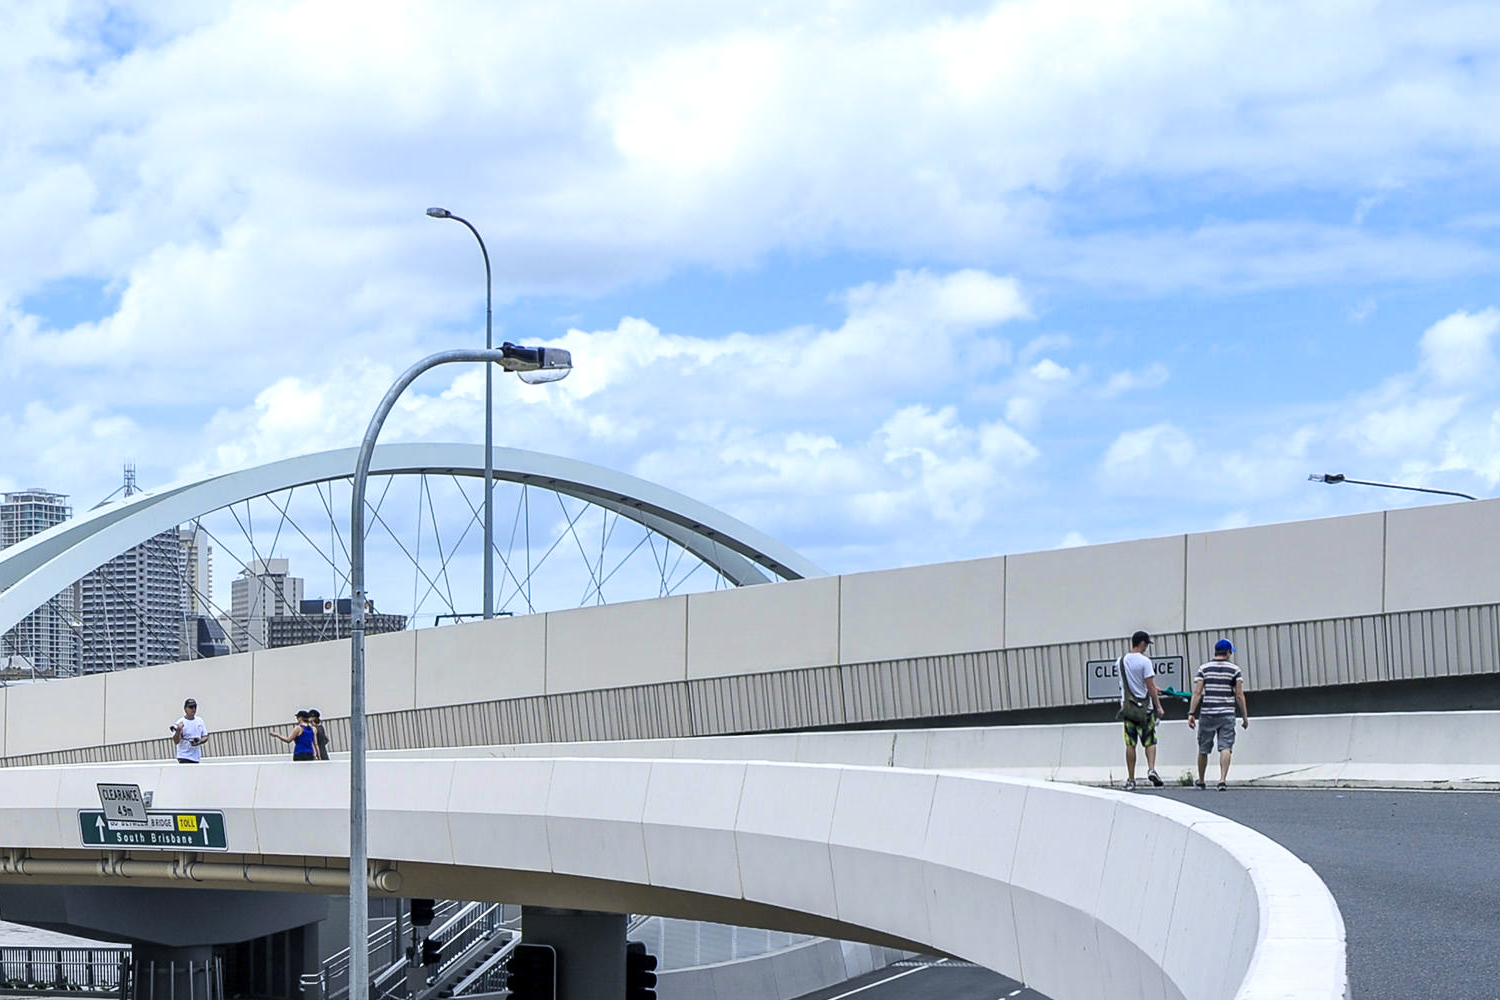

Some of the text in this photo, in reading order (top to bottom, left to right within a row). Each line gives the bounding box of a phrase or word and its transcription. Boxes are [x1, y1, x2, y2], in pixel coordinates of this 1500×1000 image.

[102, 789, 140, 801] CLEARANCE
[179, 819, 196, 828] TOLL
[116, 832, 193, 844] South Brisbane
